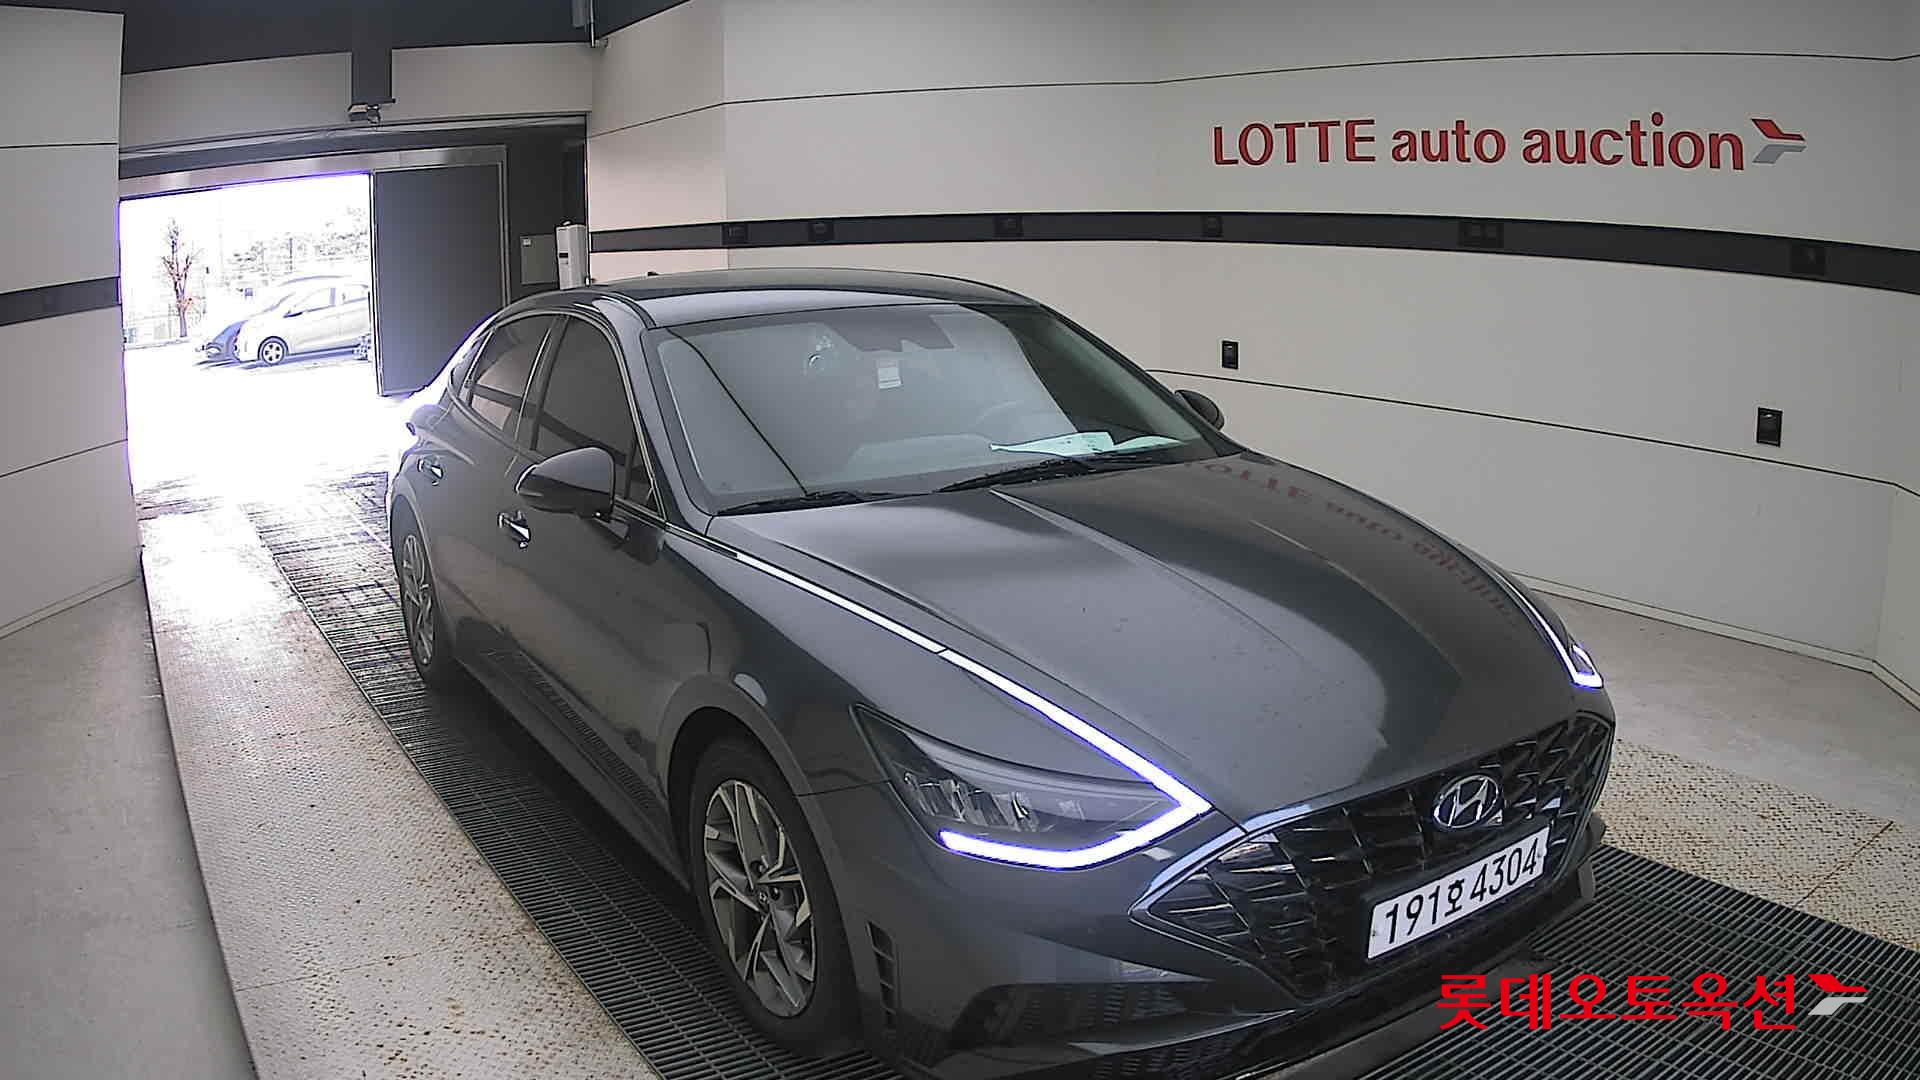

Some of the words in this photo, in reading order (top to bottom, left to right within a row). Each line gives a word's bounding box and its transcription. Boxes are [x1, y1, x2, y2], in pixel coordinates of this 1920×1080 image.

[1213, 118, 1377, 165] LOTTE
[1391, 119, 1506, 164] auto
[1522, 112, 1745, 170] auction
